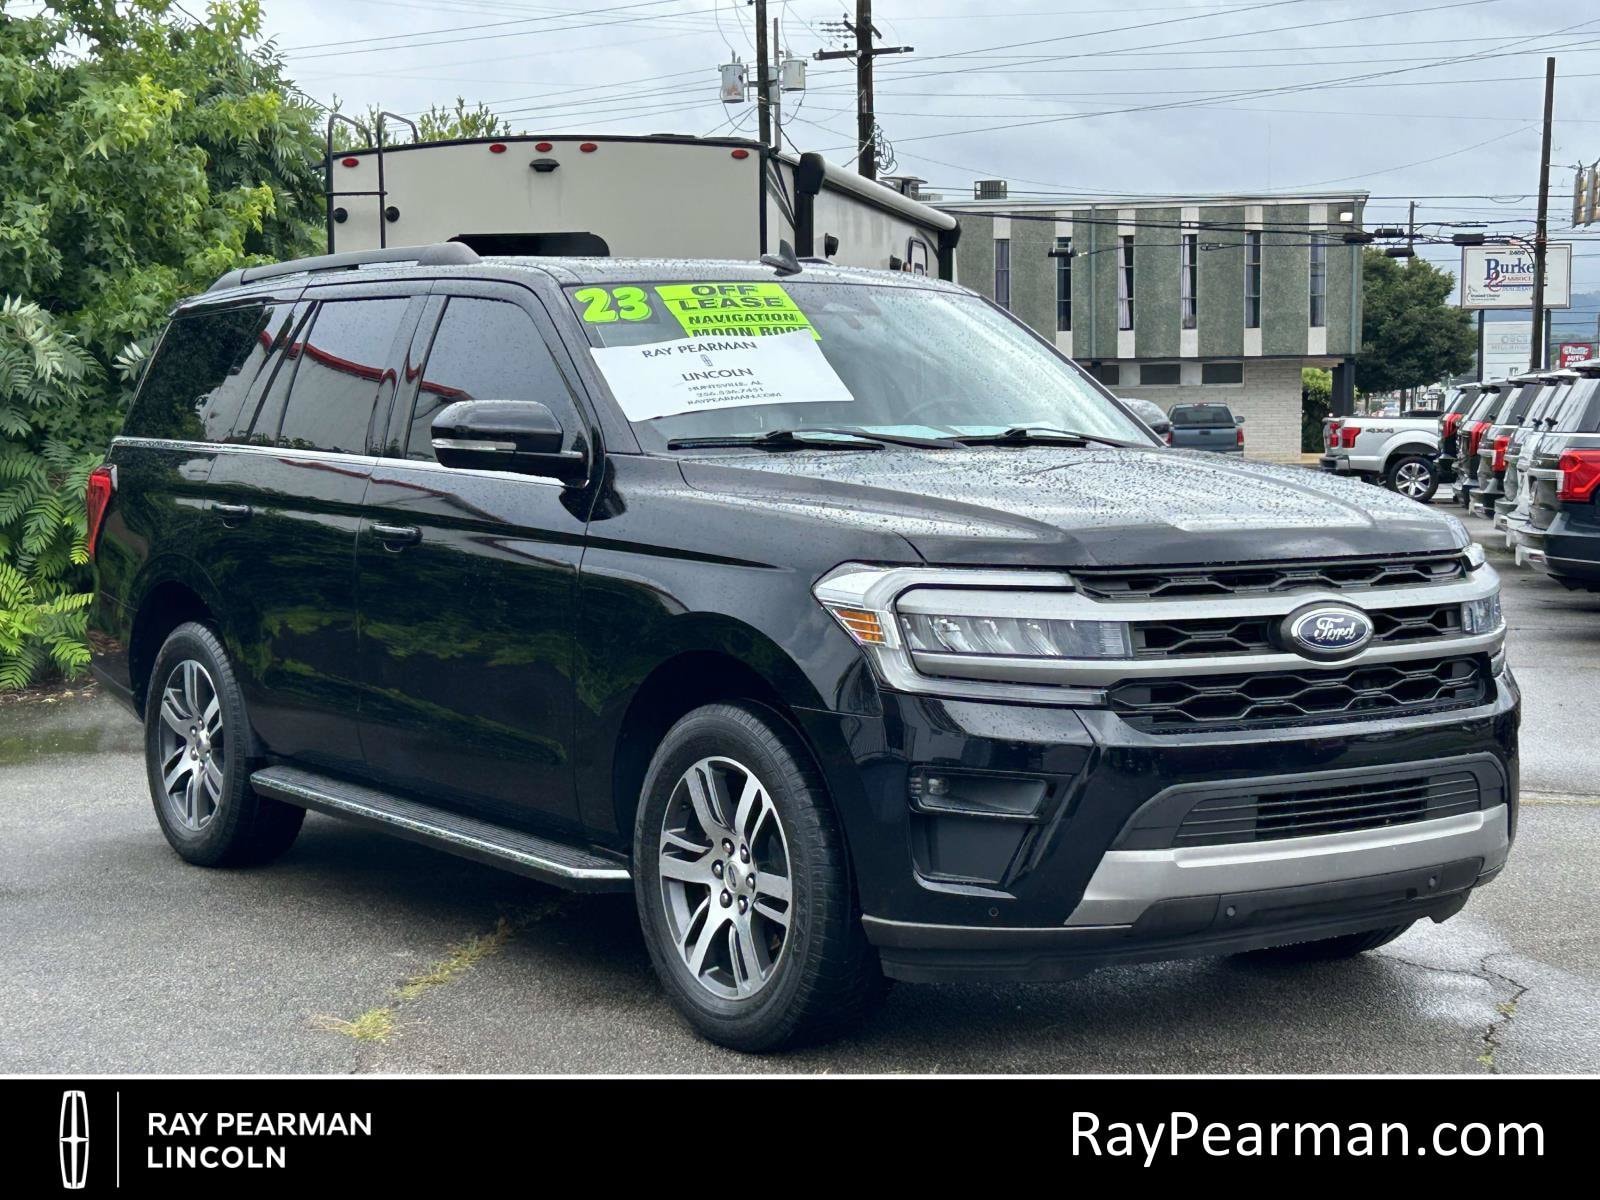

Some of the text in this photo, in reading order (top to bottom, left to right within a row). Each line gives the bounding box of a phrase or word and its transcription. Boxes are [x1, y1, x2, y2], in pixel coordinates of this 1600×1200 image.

[691, 284, 759, 297] OFF
[574, 286, 653, 324] 23
[678, 296, 787, 311] LEASE
[688, 313, 798, 326] NAVIGATION
[692, 326, 756, 338] MOON
[642, 340, 759, 359] RAY PEARMAN
[681, 366, 755, 382] LINCOLN
[1313, 617, 1357, 641] Ford
